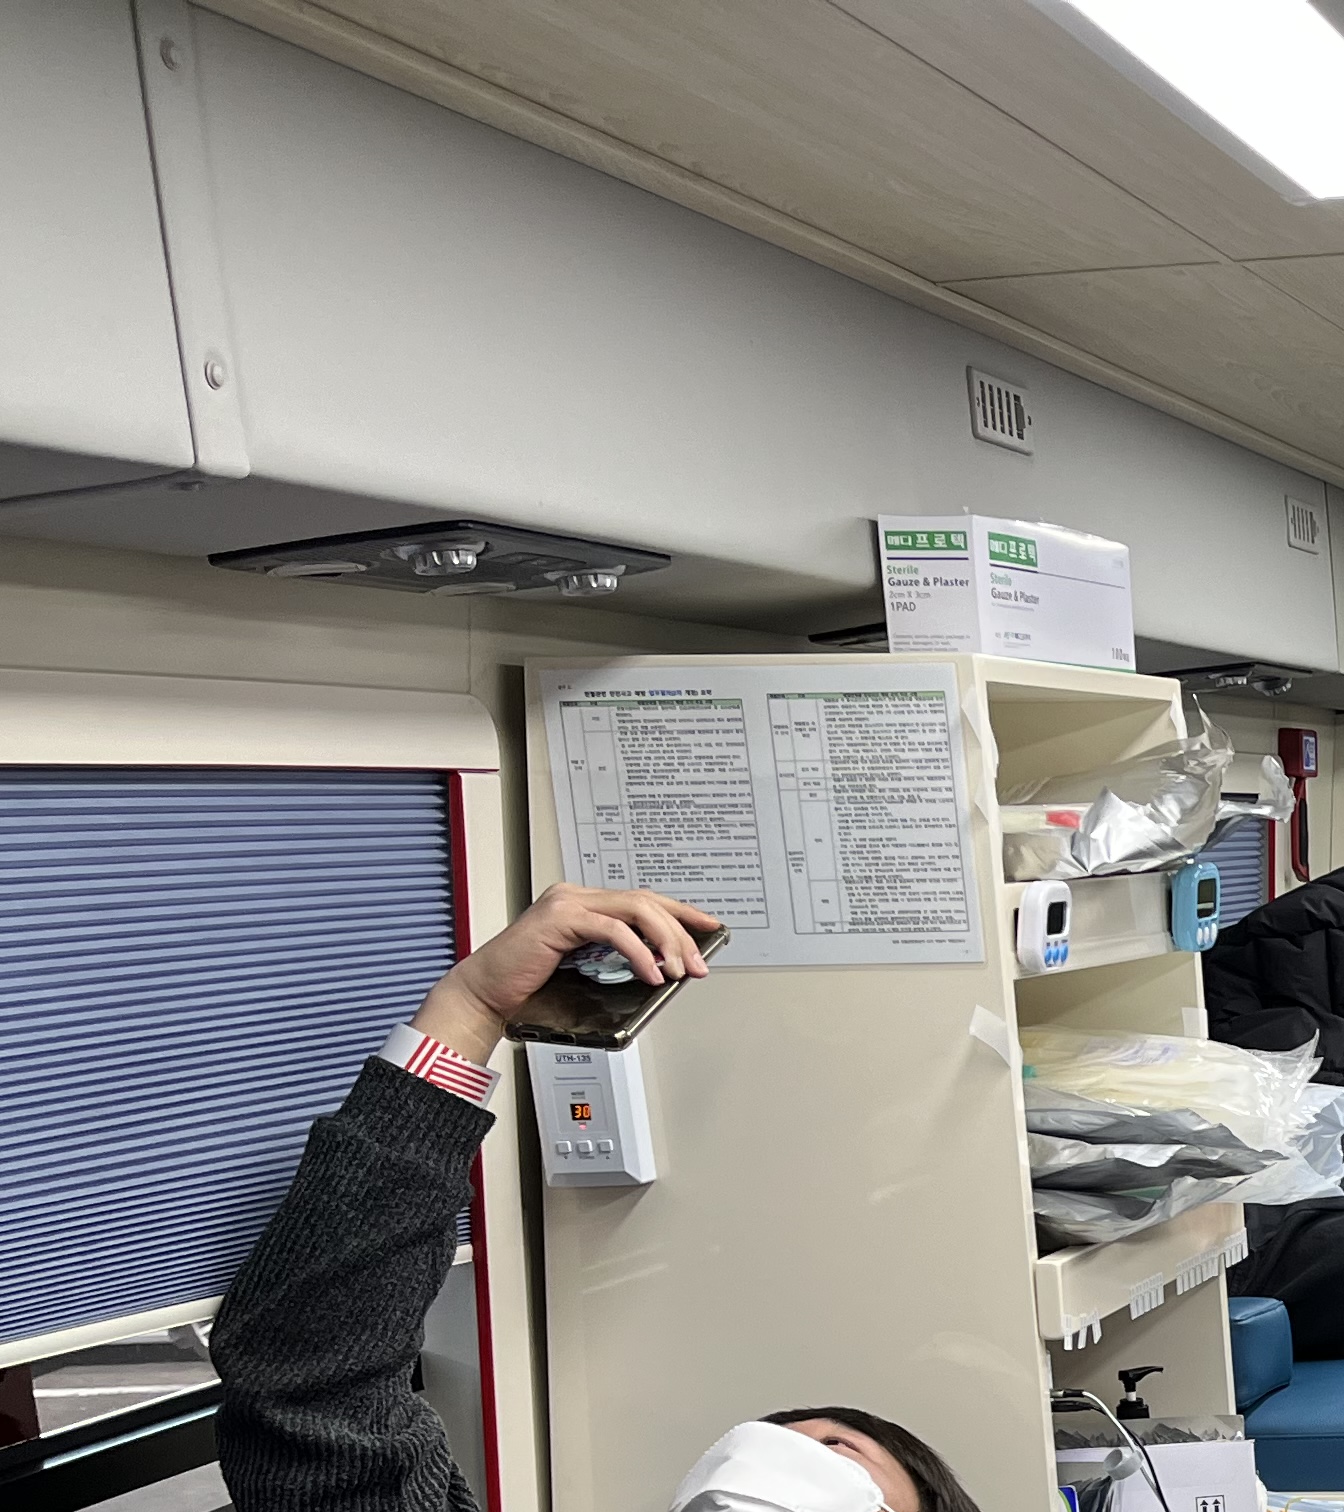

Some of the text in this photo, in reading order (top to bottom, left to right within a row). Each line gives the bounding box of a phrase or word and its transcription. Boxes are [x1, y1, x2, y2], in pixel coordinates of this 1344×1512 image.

[886, 565, 919, 575] Sterile
[888, 577, 969, 587] Gauze & Plaster
[890, 602, 916, 612] 1PAD
